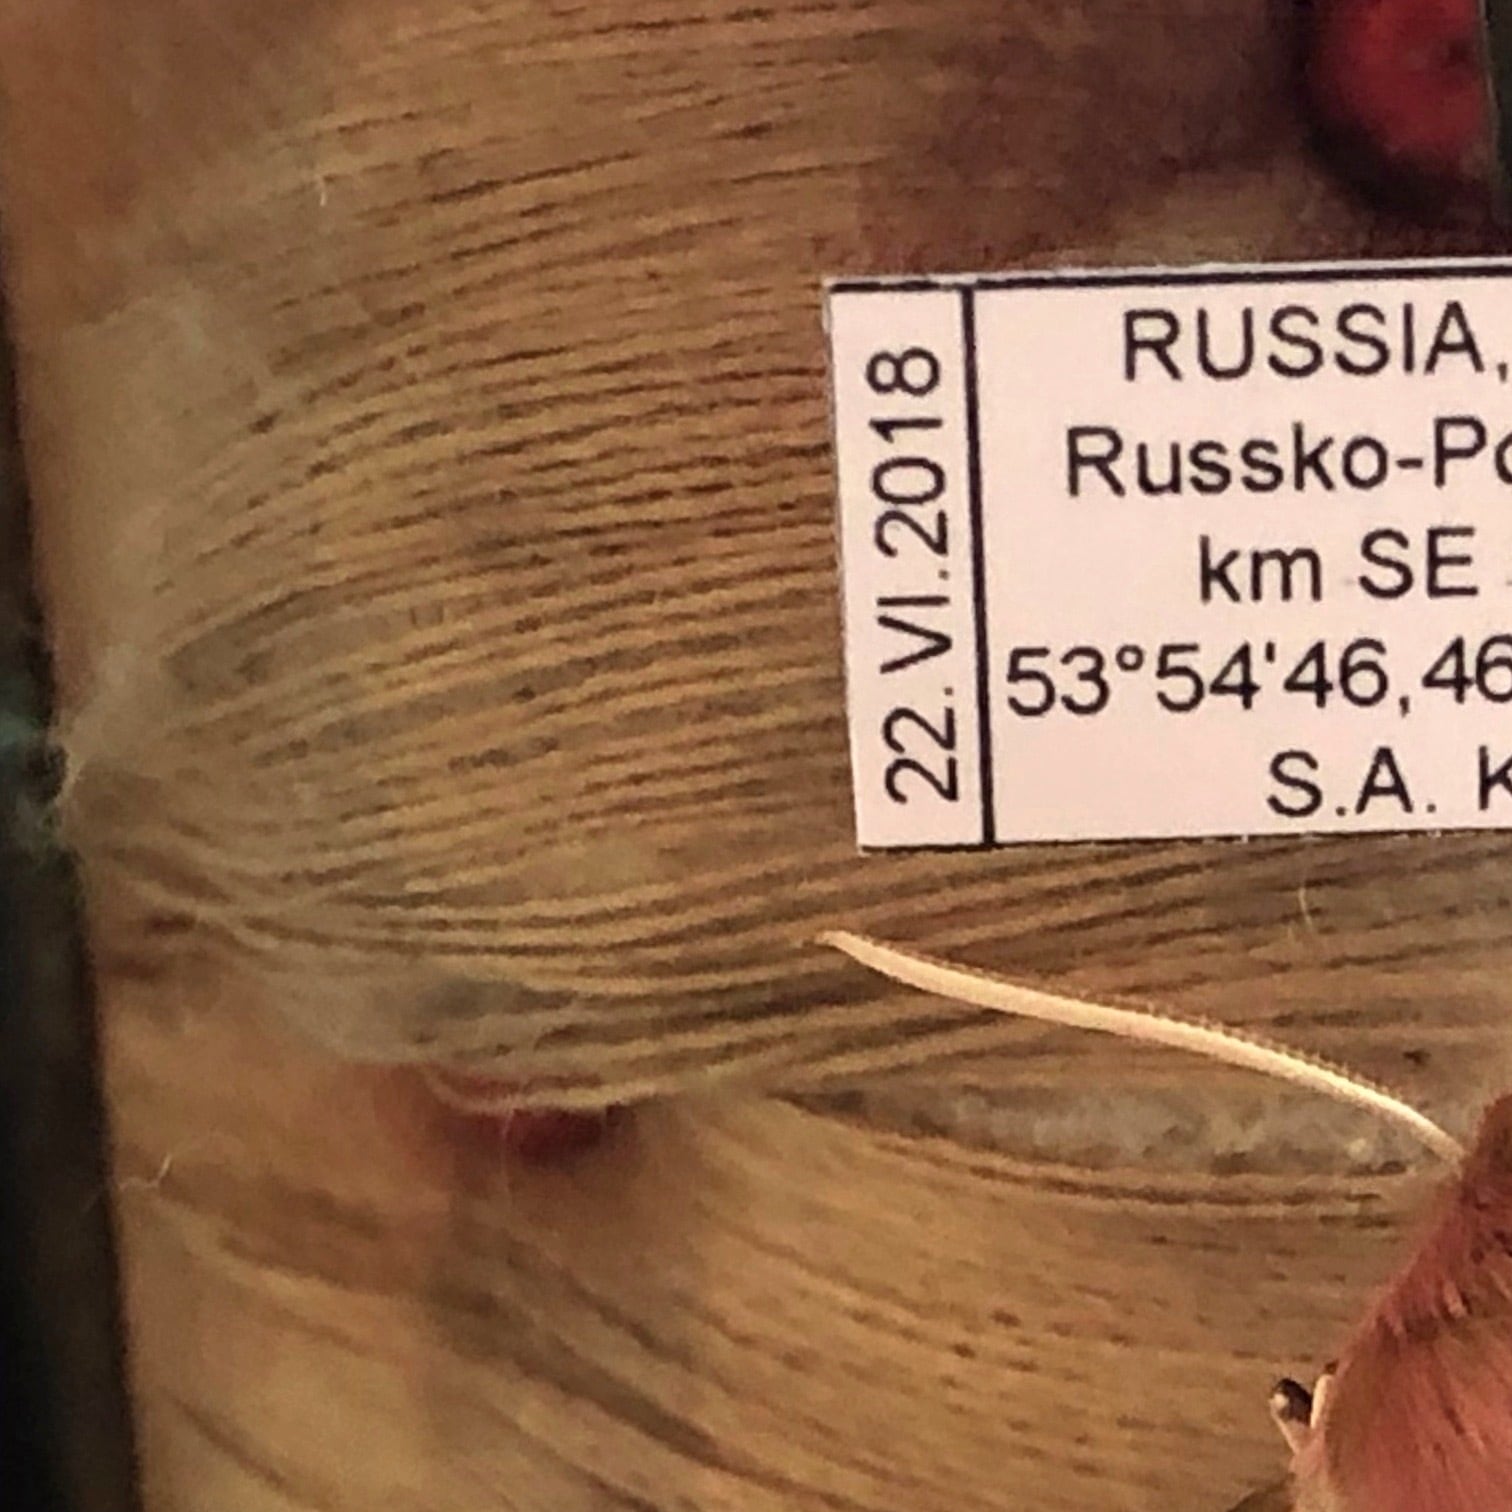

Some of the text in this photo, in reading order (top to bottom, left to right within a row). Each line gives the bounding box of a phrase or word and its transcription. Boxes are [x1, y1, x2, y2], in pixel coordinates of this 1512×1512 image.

[1124, 300, 1508, 382] RUSSIA,
[865, 347, 960, 804] 22.VI.2018
[1199, 535, 1322, 603] km
[1358, 526, 1479, 600] SE
[1266, 746, 1437, 818] S.A.
